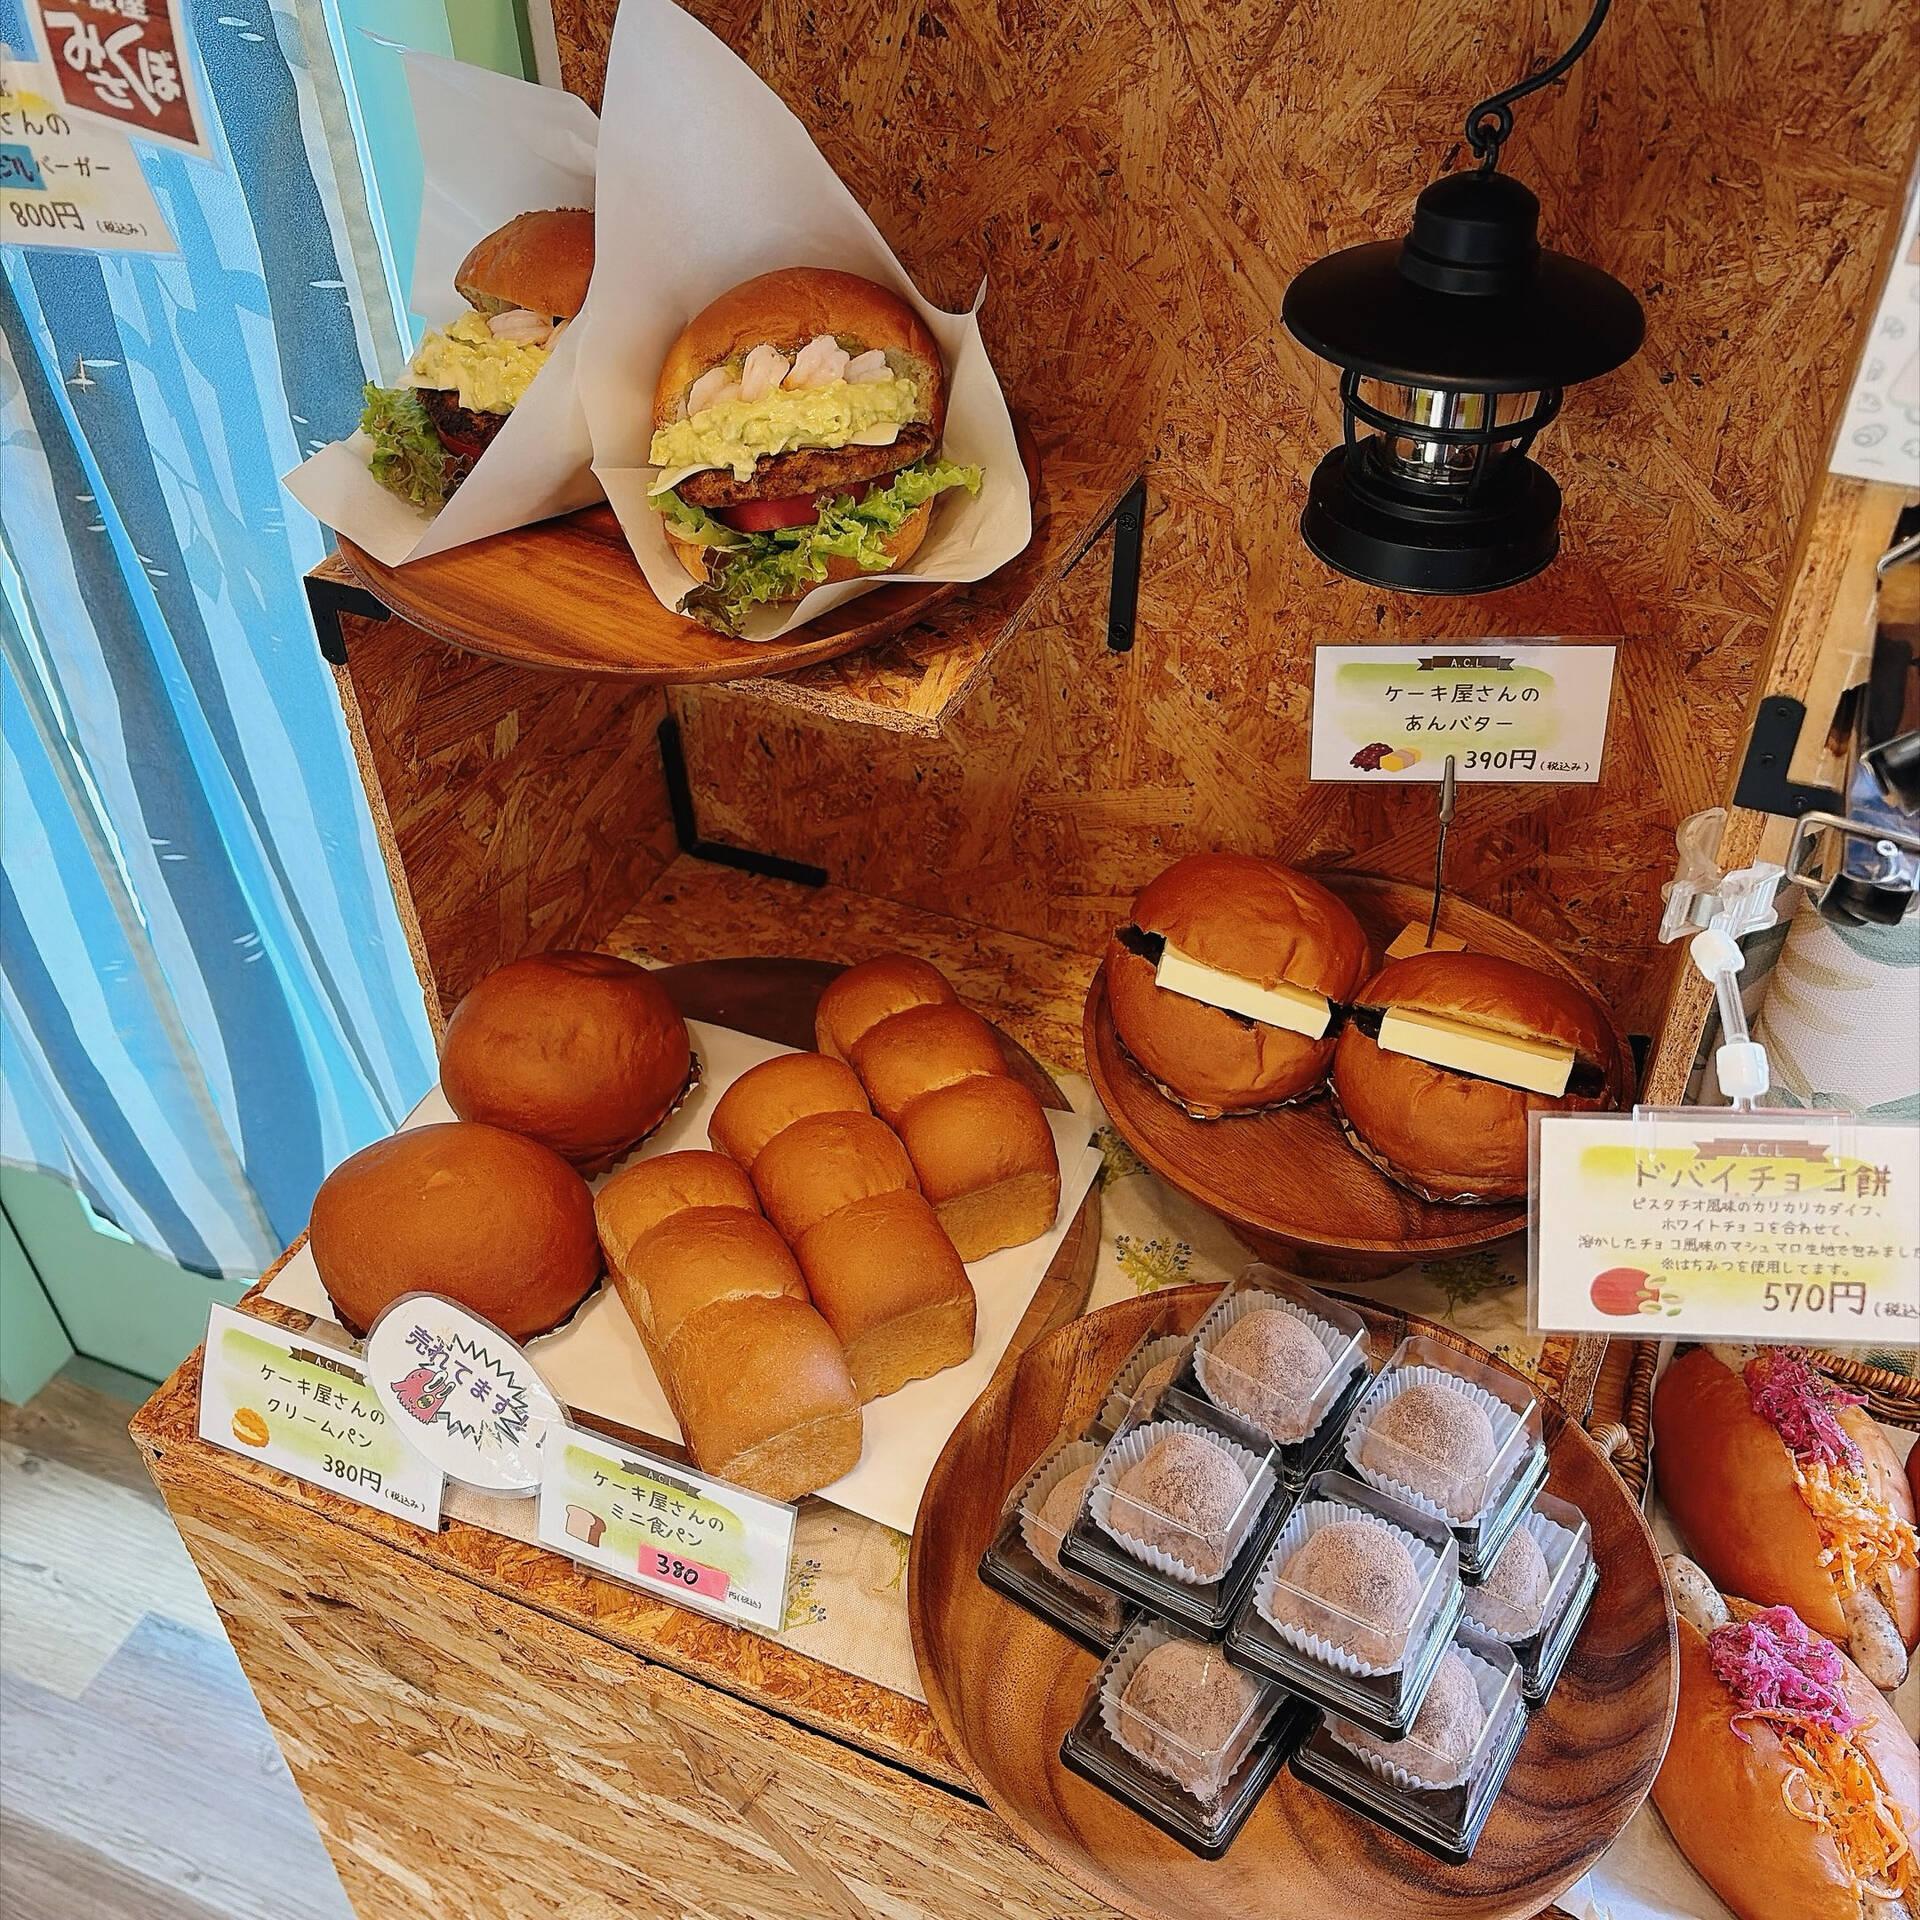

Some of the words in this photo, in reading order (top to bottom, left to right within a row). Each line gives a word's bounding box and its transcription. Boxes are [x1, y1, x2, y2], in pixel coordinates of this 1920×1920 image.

[9, 201, 85, 231] 800円
[1384, 683, 1541, 704] ケーキ屋さんの
[1405, 714, 1513, 732] あんバター
[1463, 749, 1537, 771] 390円
[1634, 1162, 1893, 1198] ドバイチョコ餅
[1762, 1281, 1867, 1316] 570円
[259, 1365, 385, 1426] ケーキ屋さんの
[266, 1398, 374, 1449] クリームパン
[321, 1454, 383, 1493] 380円
[592, 1471, 725, 1533] ケーキ屋さんの
[611, 1503, 703, 1547] ミニ食パン
[655, 1552, 700, 1586] 380
